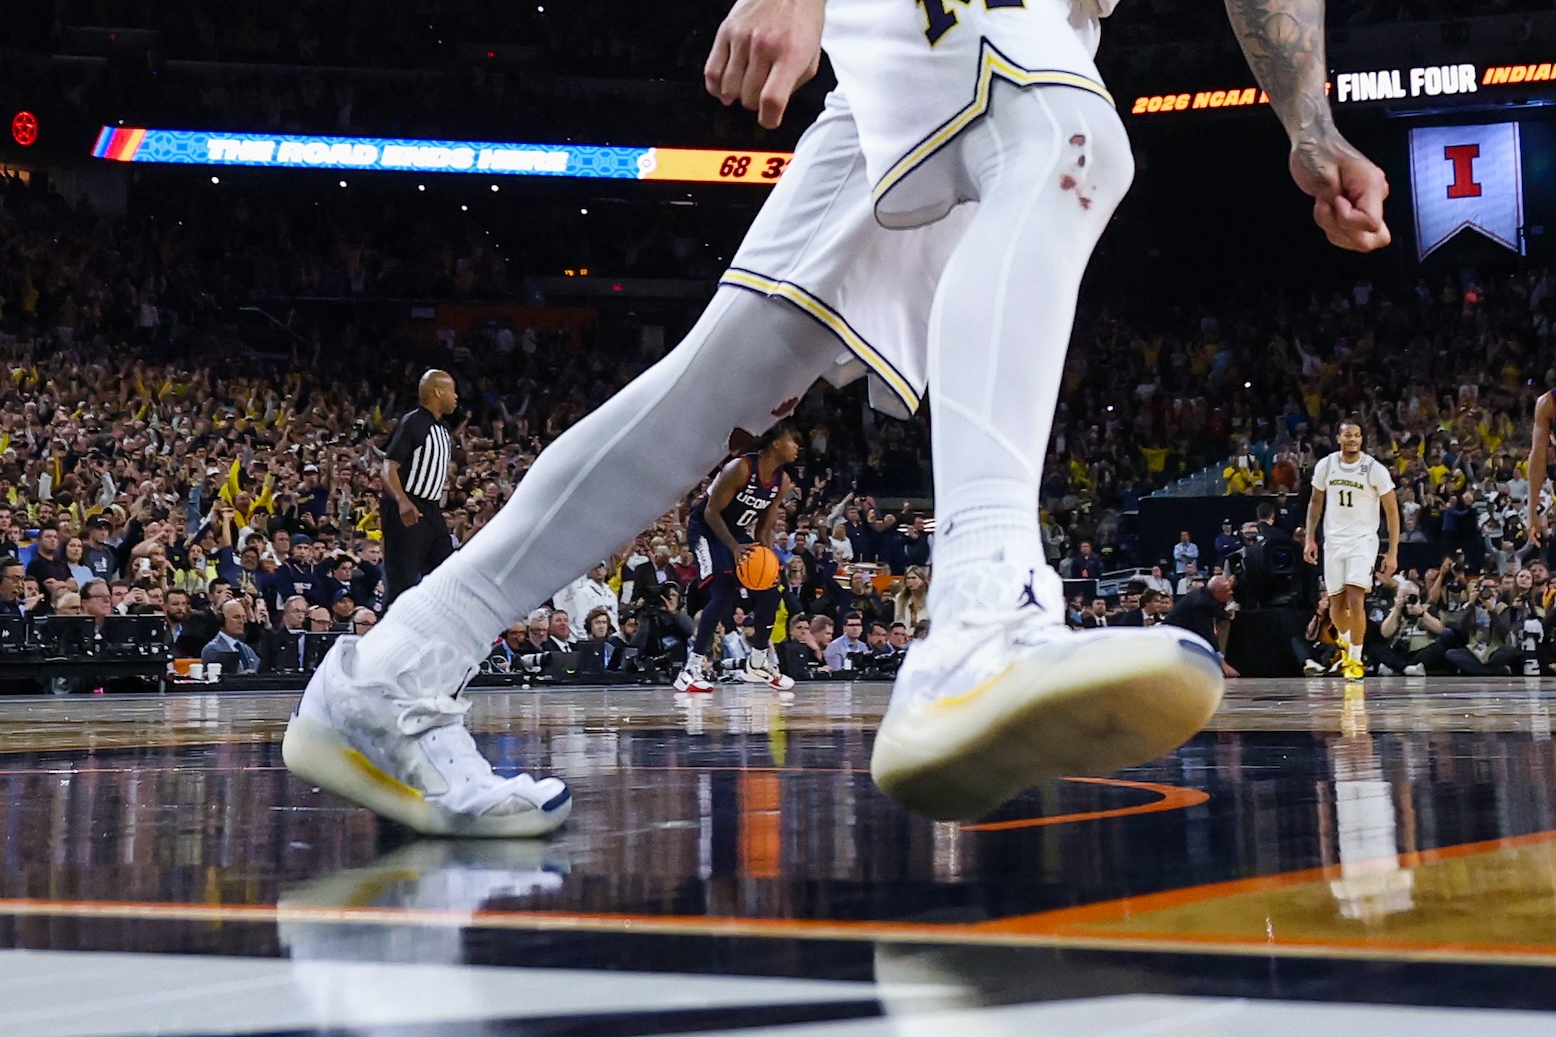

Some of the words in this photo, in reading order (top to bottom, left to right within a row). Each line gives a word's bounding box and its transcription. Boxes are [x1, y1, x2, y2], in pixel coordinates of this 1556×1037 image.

[1132, 96, 1190, 114] 2026
[1192, 90, 1256, 110] NCAA
[1338, 67, 1406, 103] FINAL
[1410, 64, 1477, 96] FOUR
[206, 138, 275, 162] THE
[277, 142, 378, 165] ROAD
[720, 156, 751, 177] 68
[1339, 490, 1353, 508] 11
